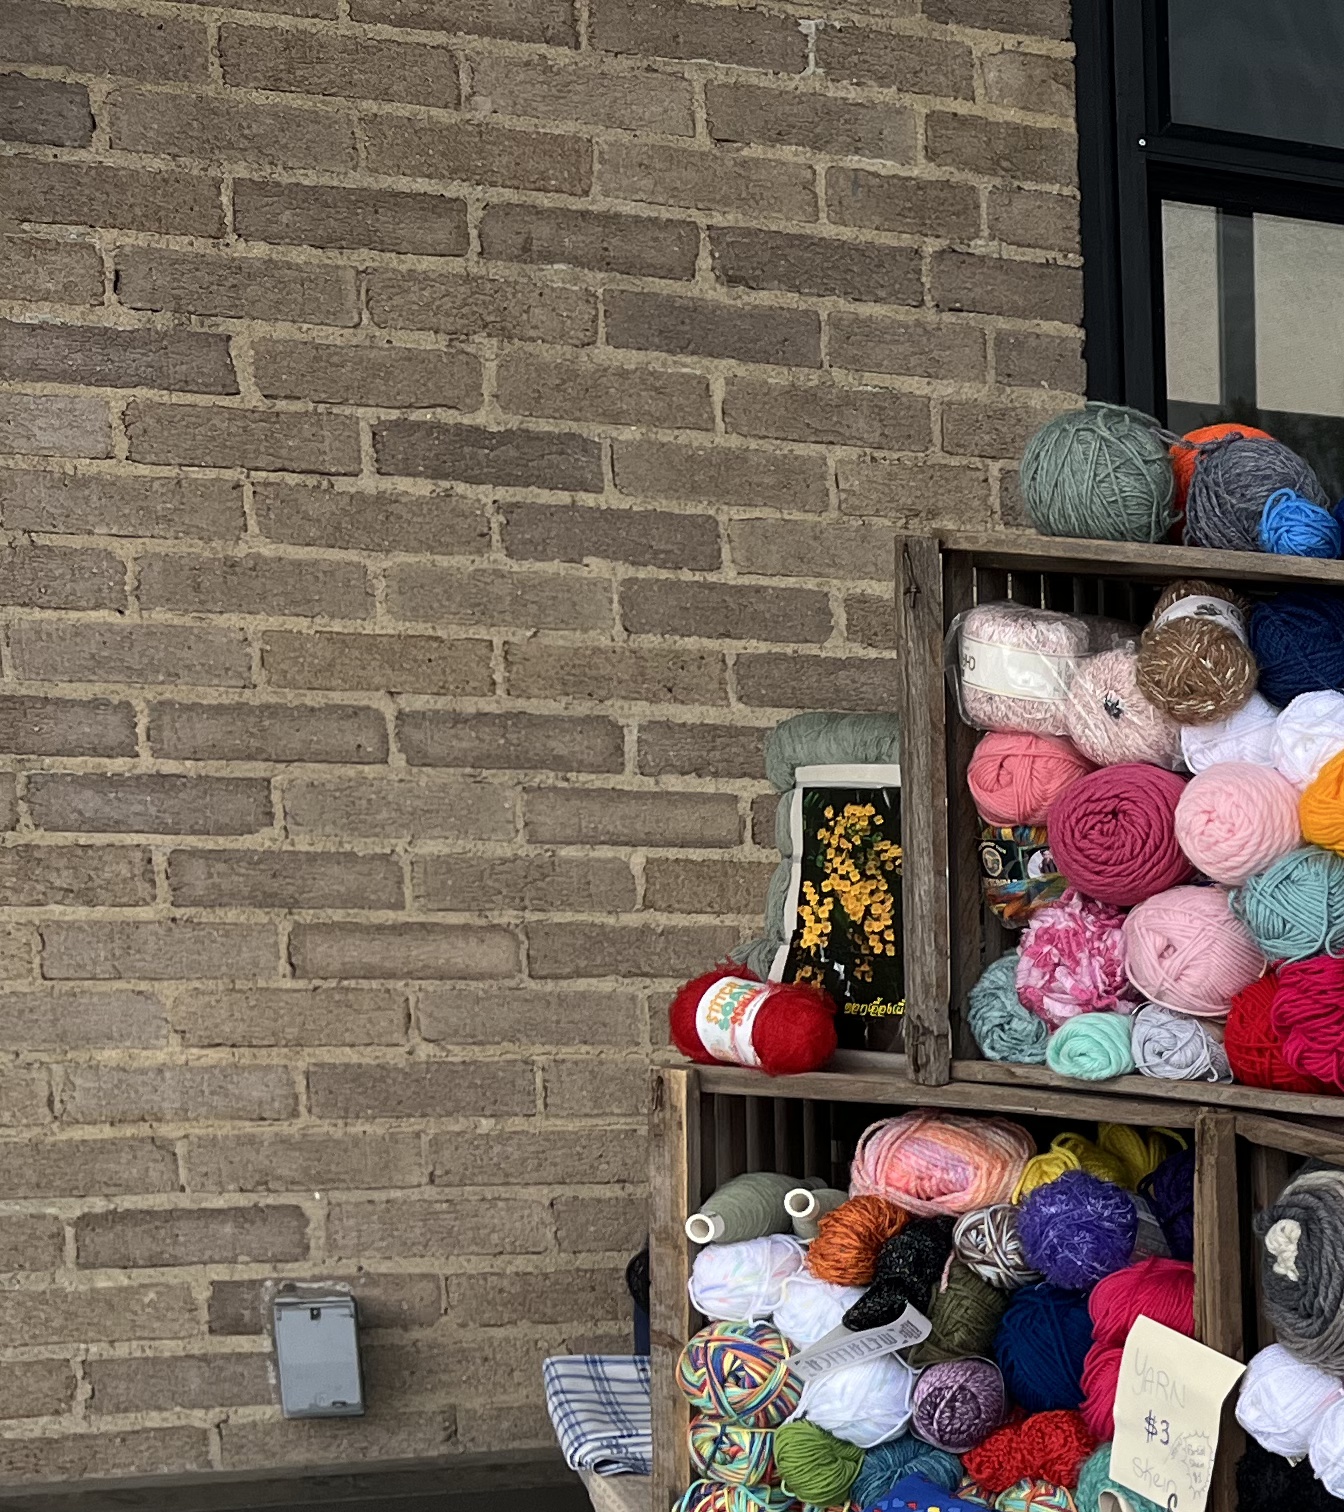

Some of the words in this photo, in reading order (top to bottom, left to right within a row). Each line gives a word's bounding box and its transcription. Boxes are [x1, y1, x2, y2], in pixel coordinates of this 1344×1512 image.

[1132, 1348, 1186, 1409] YARN
[1144, 1409, 1171, 1446] $3
[1132, 1457, 1177, 1494] Skein
